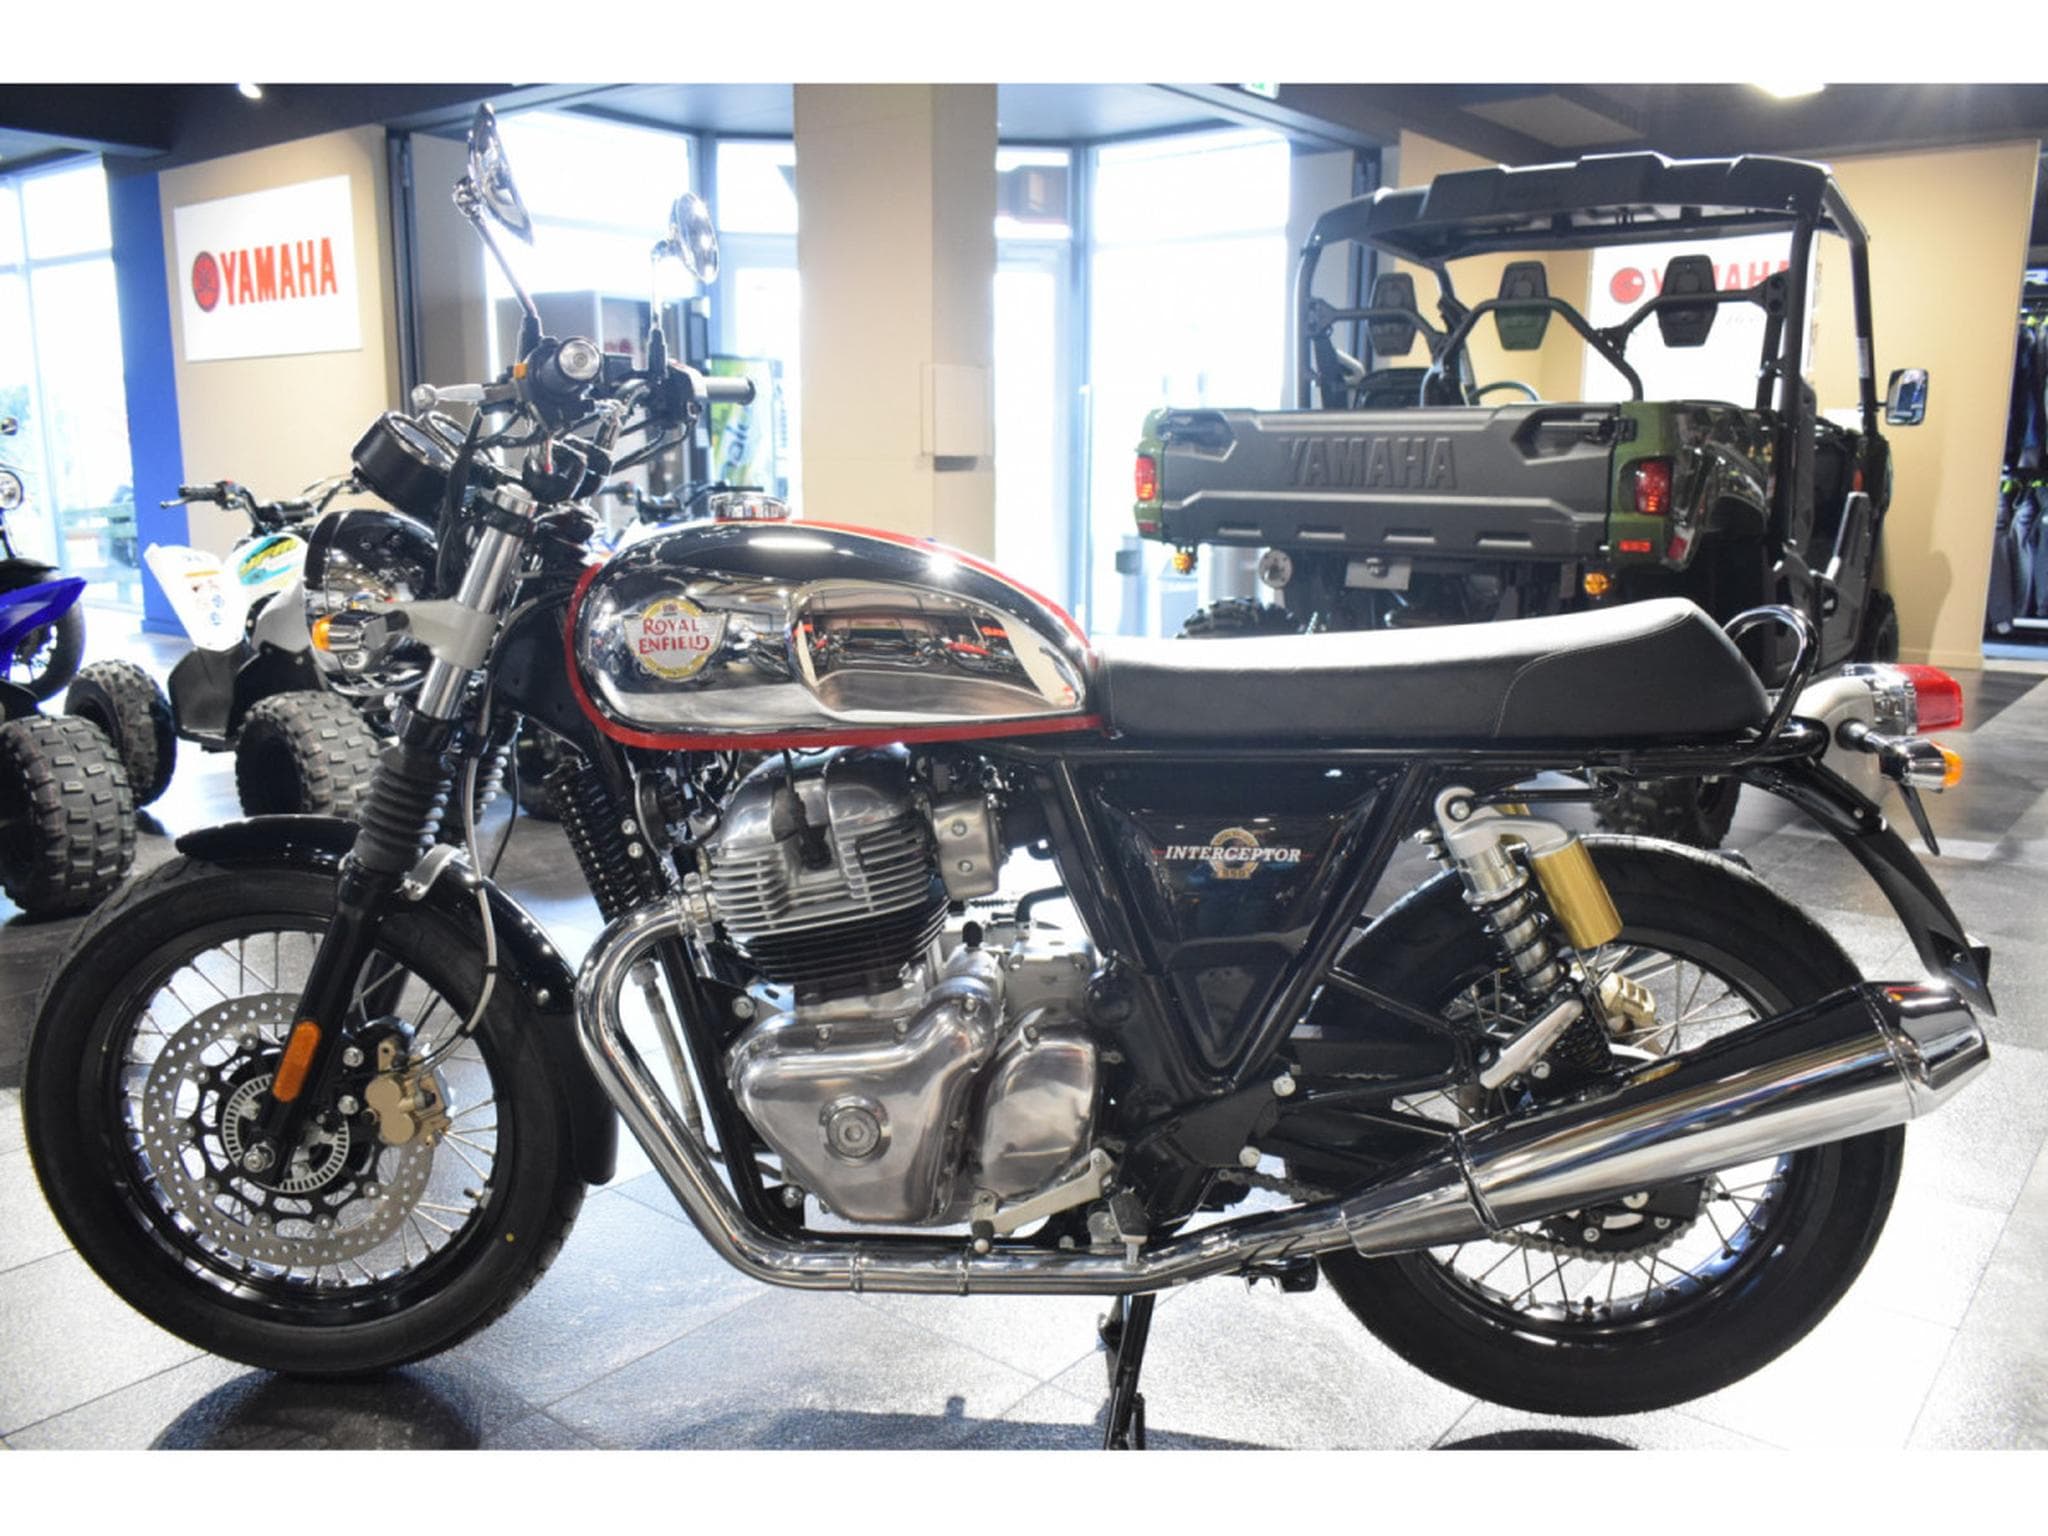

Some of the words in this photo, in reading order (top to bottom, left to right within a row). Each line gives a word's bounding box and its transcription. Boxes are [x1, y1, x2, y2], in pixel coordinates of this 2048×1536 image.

[219, 237, 338, 306] YAMAHA
[1277, 437, 1458, 490] YAMAHA
[643, 618, 699, 635] ROYAL
[639, 636, 710, 655] ENFIELD
[1165, 845, 1302, 863] INTERCEPTOR
